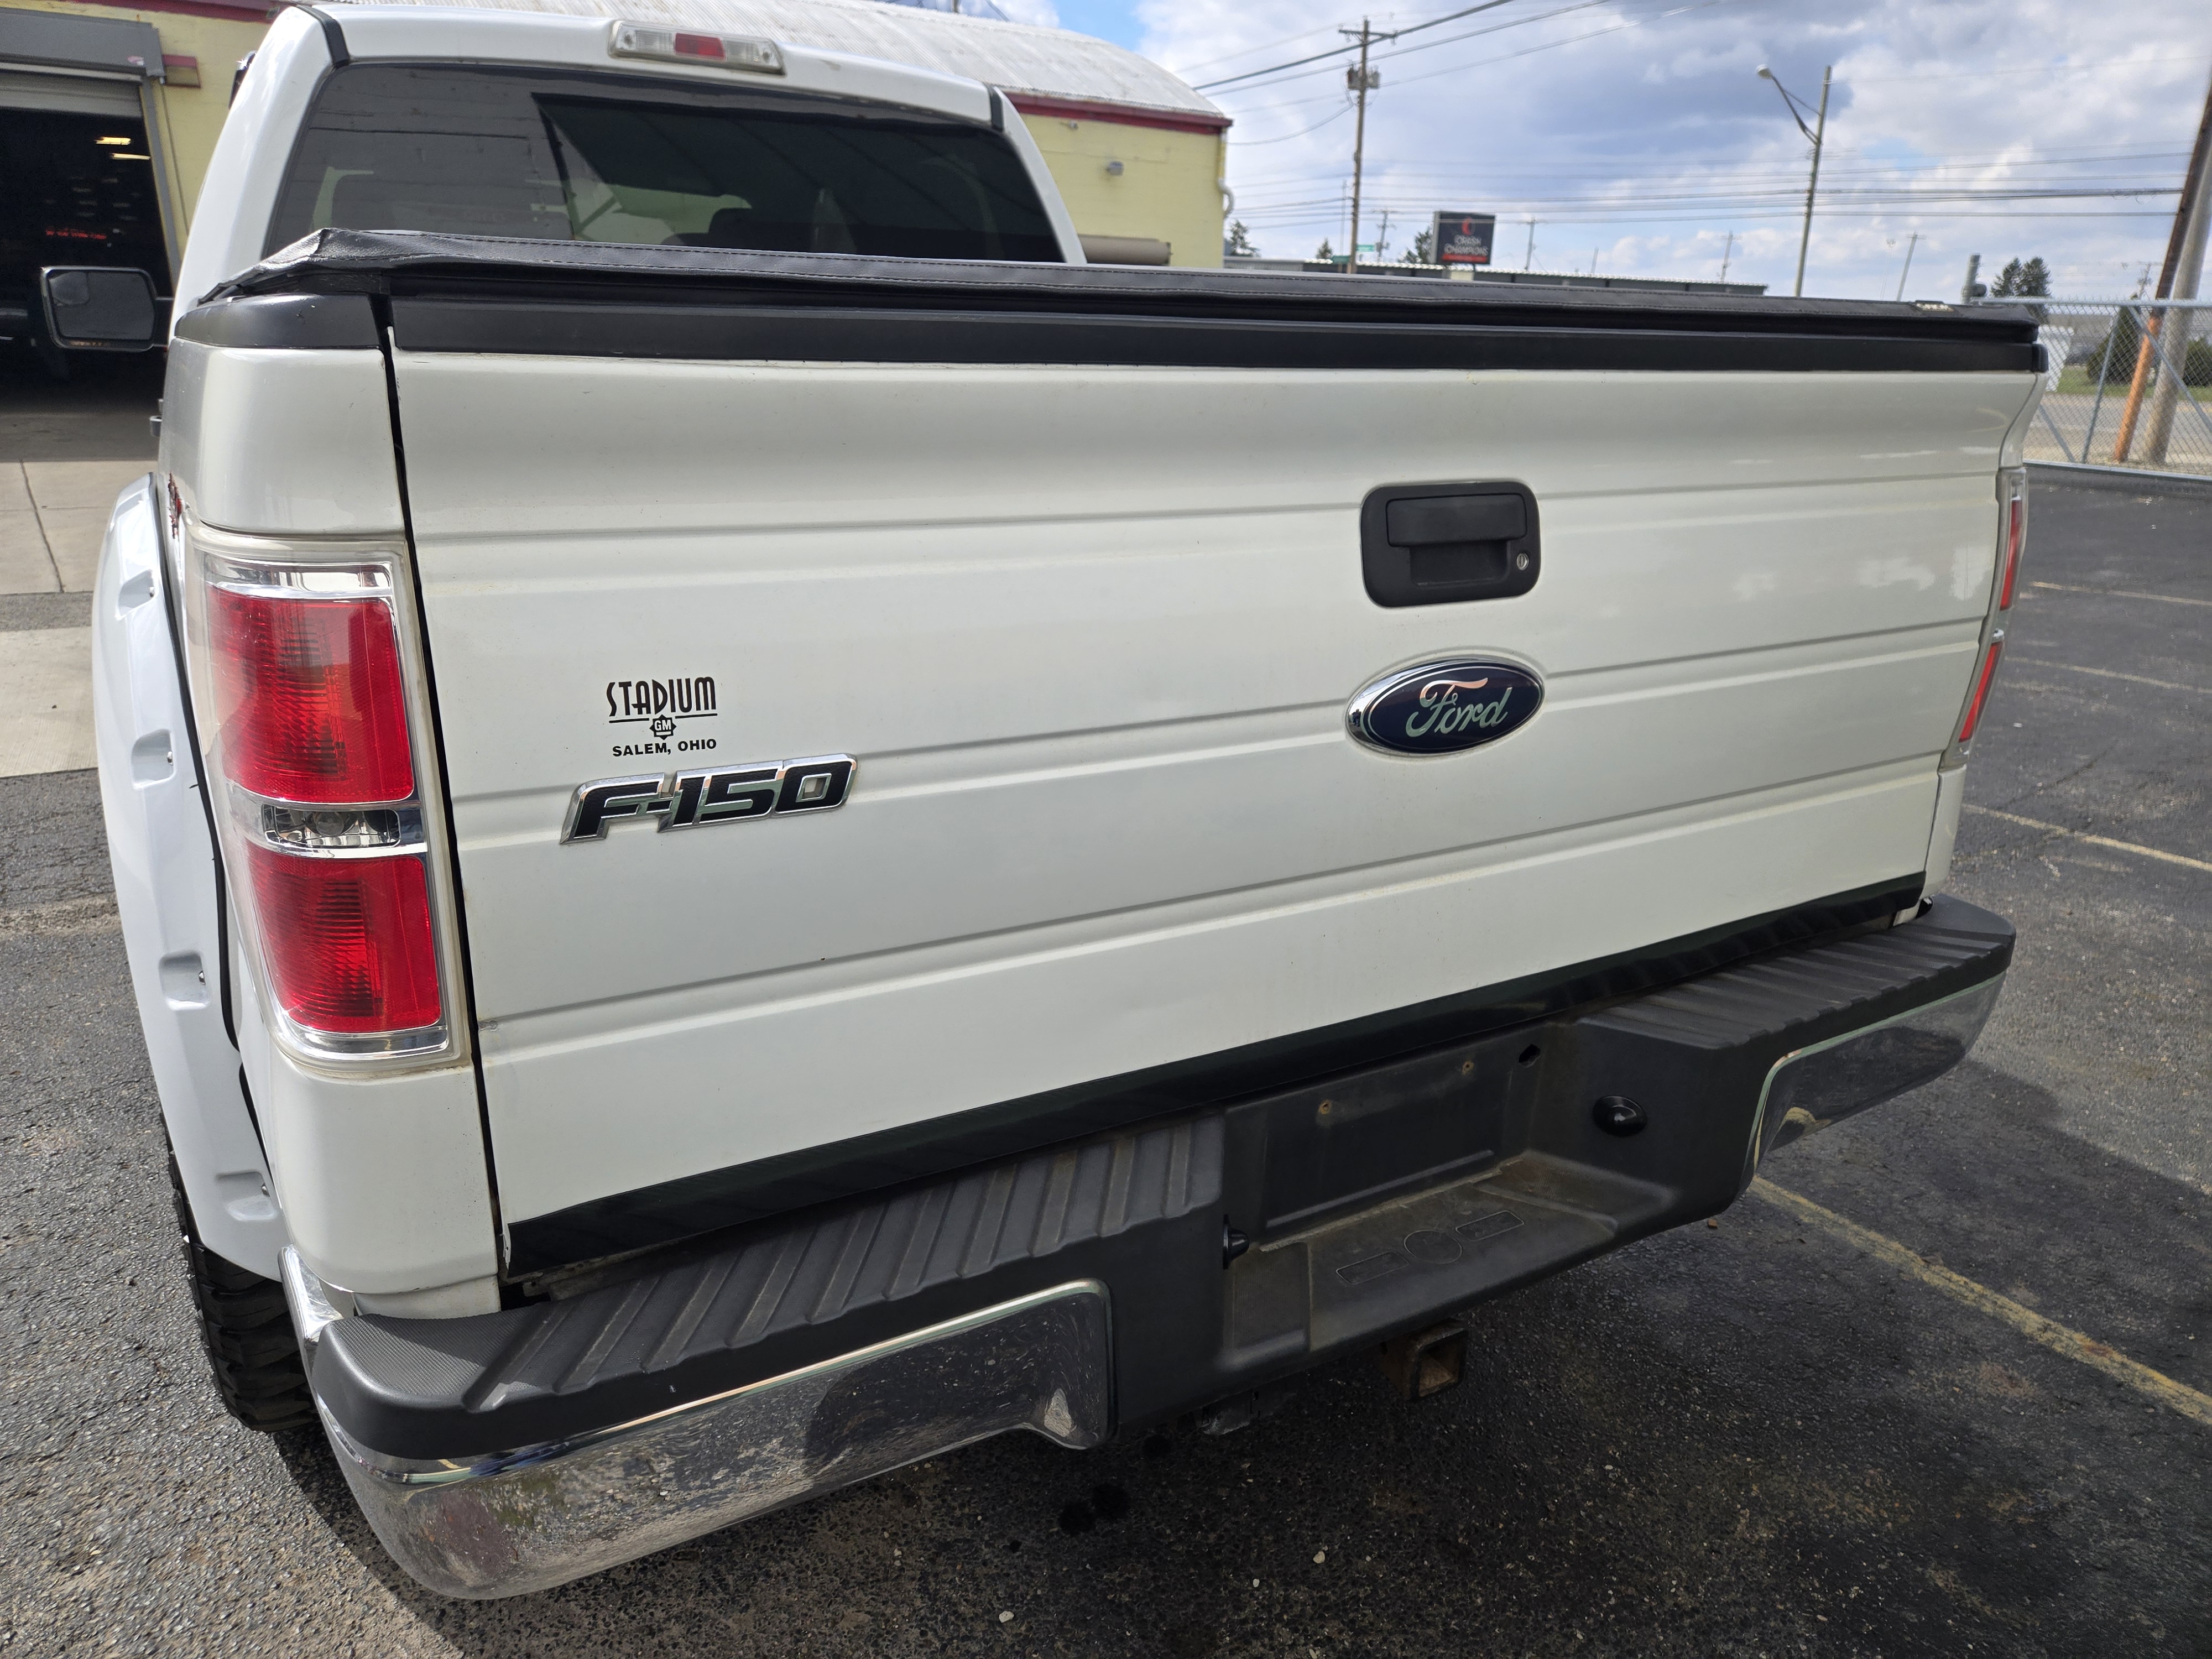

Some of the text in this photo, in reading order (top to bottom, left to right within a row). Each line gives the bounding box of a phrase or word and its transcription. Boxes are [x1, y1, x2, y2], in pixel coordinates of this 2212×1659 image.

[606, 676, 716, 717] STADIUM
[1405, 677, 1513, 738] Ford
[654, 719, 672, 731] GM
[612, 738, 717, 757] SALEM, OHIO
[560, 753, 857, 845] F-150
